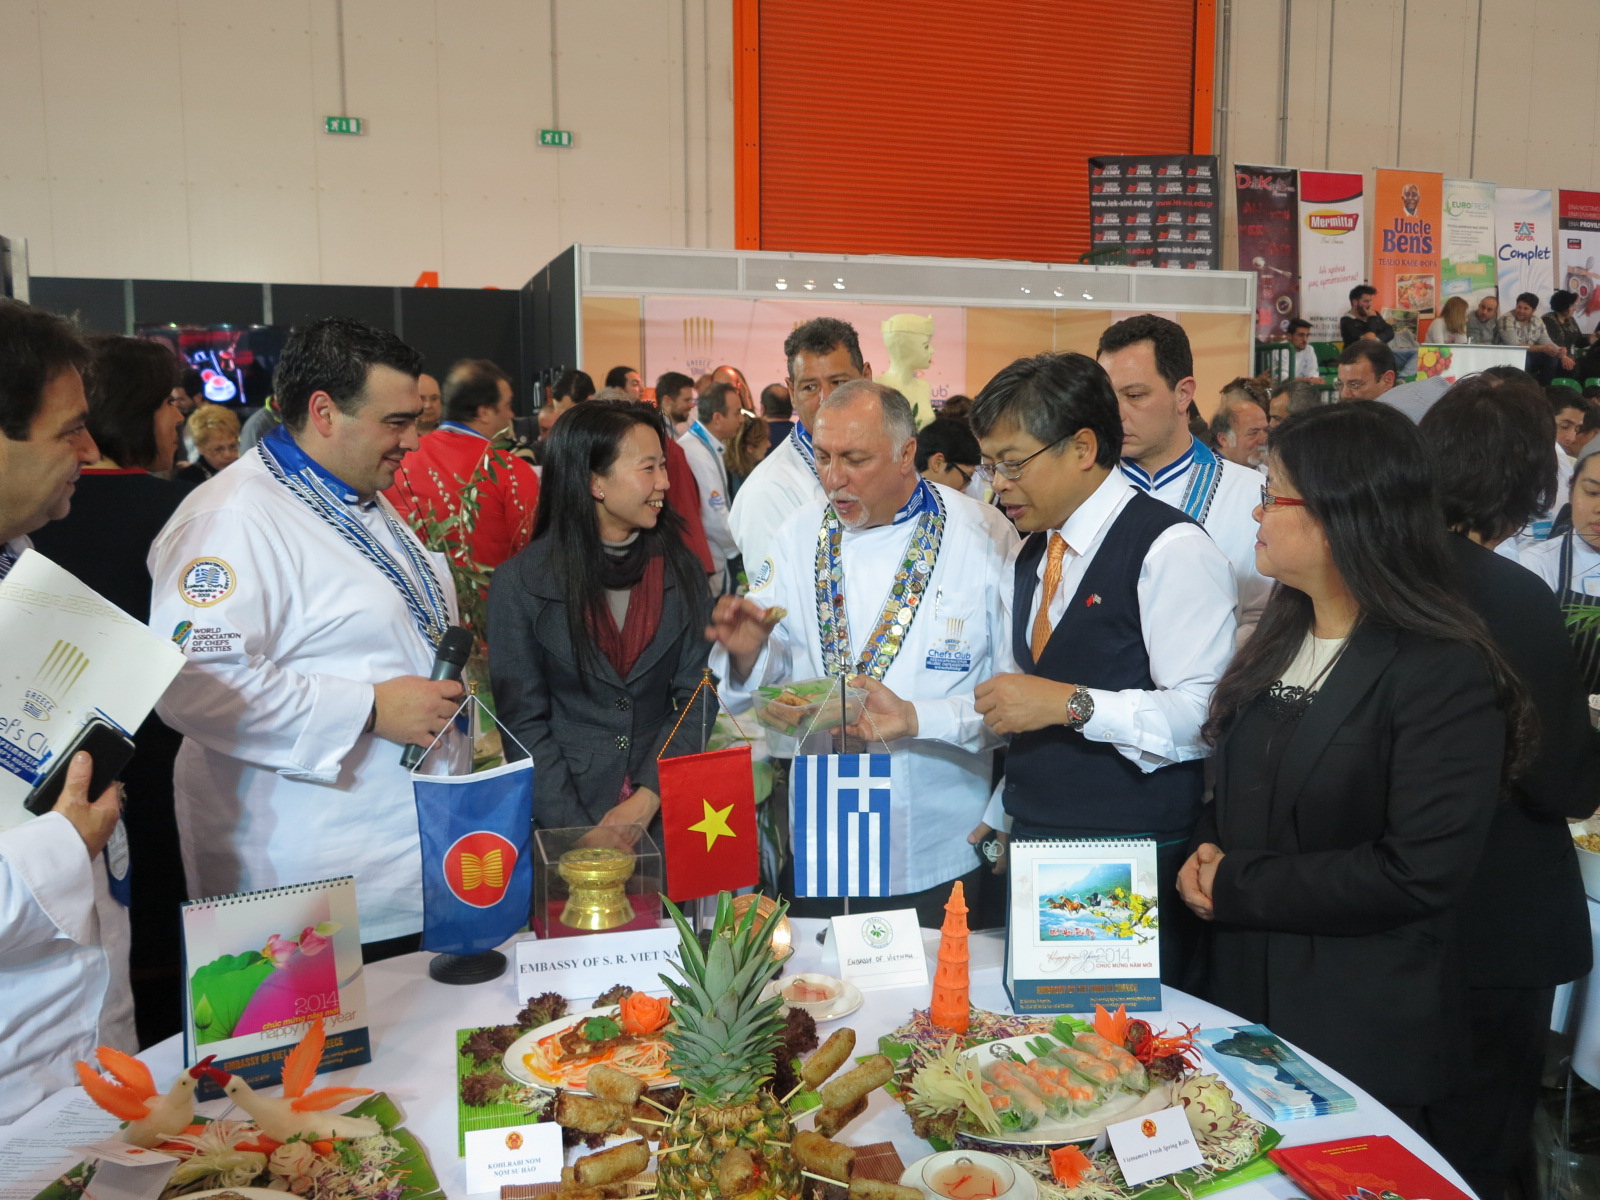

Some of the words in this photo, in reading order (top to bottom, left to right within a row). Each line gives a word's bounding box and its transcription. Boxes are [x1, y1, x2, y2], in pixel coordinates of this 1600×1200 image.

[1092, 200, 1153, 208] www.iek-xini.edu.gr
[1311, 216, 1353, 228] Mermitta
[1394, 218, 1431, 234] Uncle
[1383, 229, 1432, 254] Ben's
[1379, 258, 1400, 266] ΤΕΛΕΙΟ
[1420, 259, 1437, 267] ΦΟΡΑ
[1499, 244, 1551, 266] Complet
[932, 385, 948, 397] ub
[928, 649, 952, 658] Chef's
[25, 690, 54, 712] GREECE
[520, 959, 579, 974] EMBASSY
[583, 957, 599, 967] OF
[603, 956, 612, 965] S.
[616, 955, 627, 963] R.
[631, 951, 659, 962] VIET
[663, 950, 679, 959] NA
[1096, 948, 1131, 962] 2014
[294, 991, 339, 1015] 2014
[262, 1020, 282, 1030] chúc
[332, 1010, 356, 1026] year
[224, 1054, 259, 1071] EMBASSY
[261, 1054, 270, 1063] OF
[1123, 1152, 1148, 1163] Vietnamese
[1149, 1147, 1162, 1155] Fresh
[1163, 1143, 1178, 1152] Spring
[1178, 1139, 1189, 1147] Rolls
[488, 1160, 523, 1169] KOHLRABI
